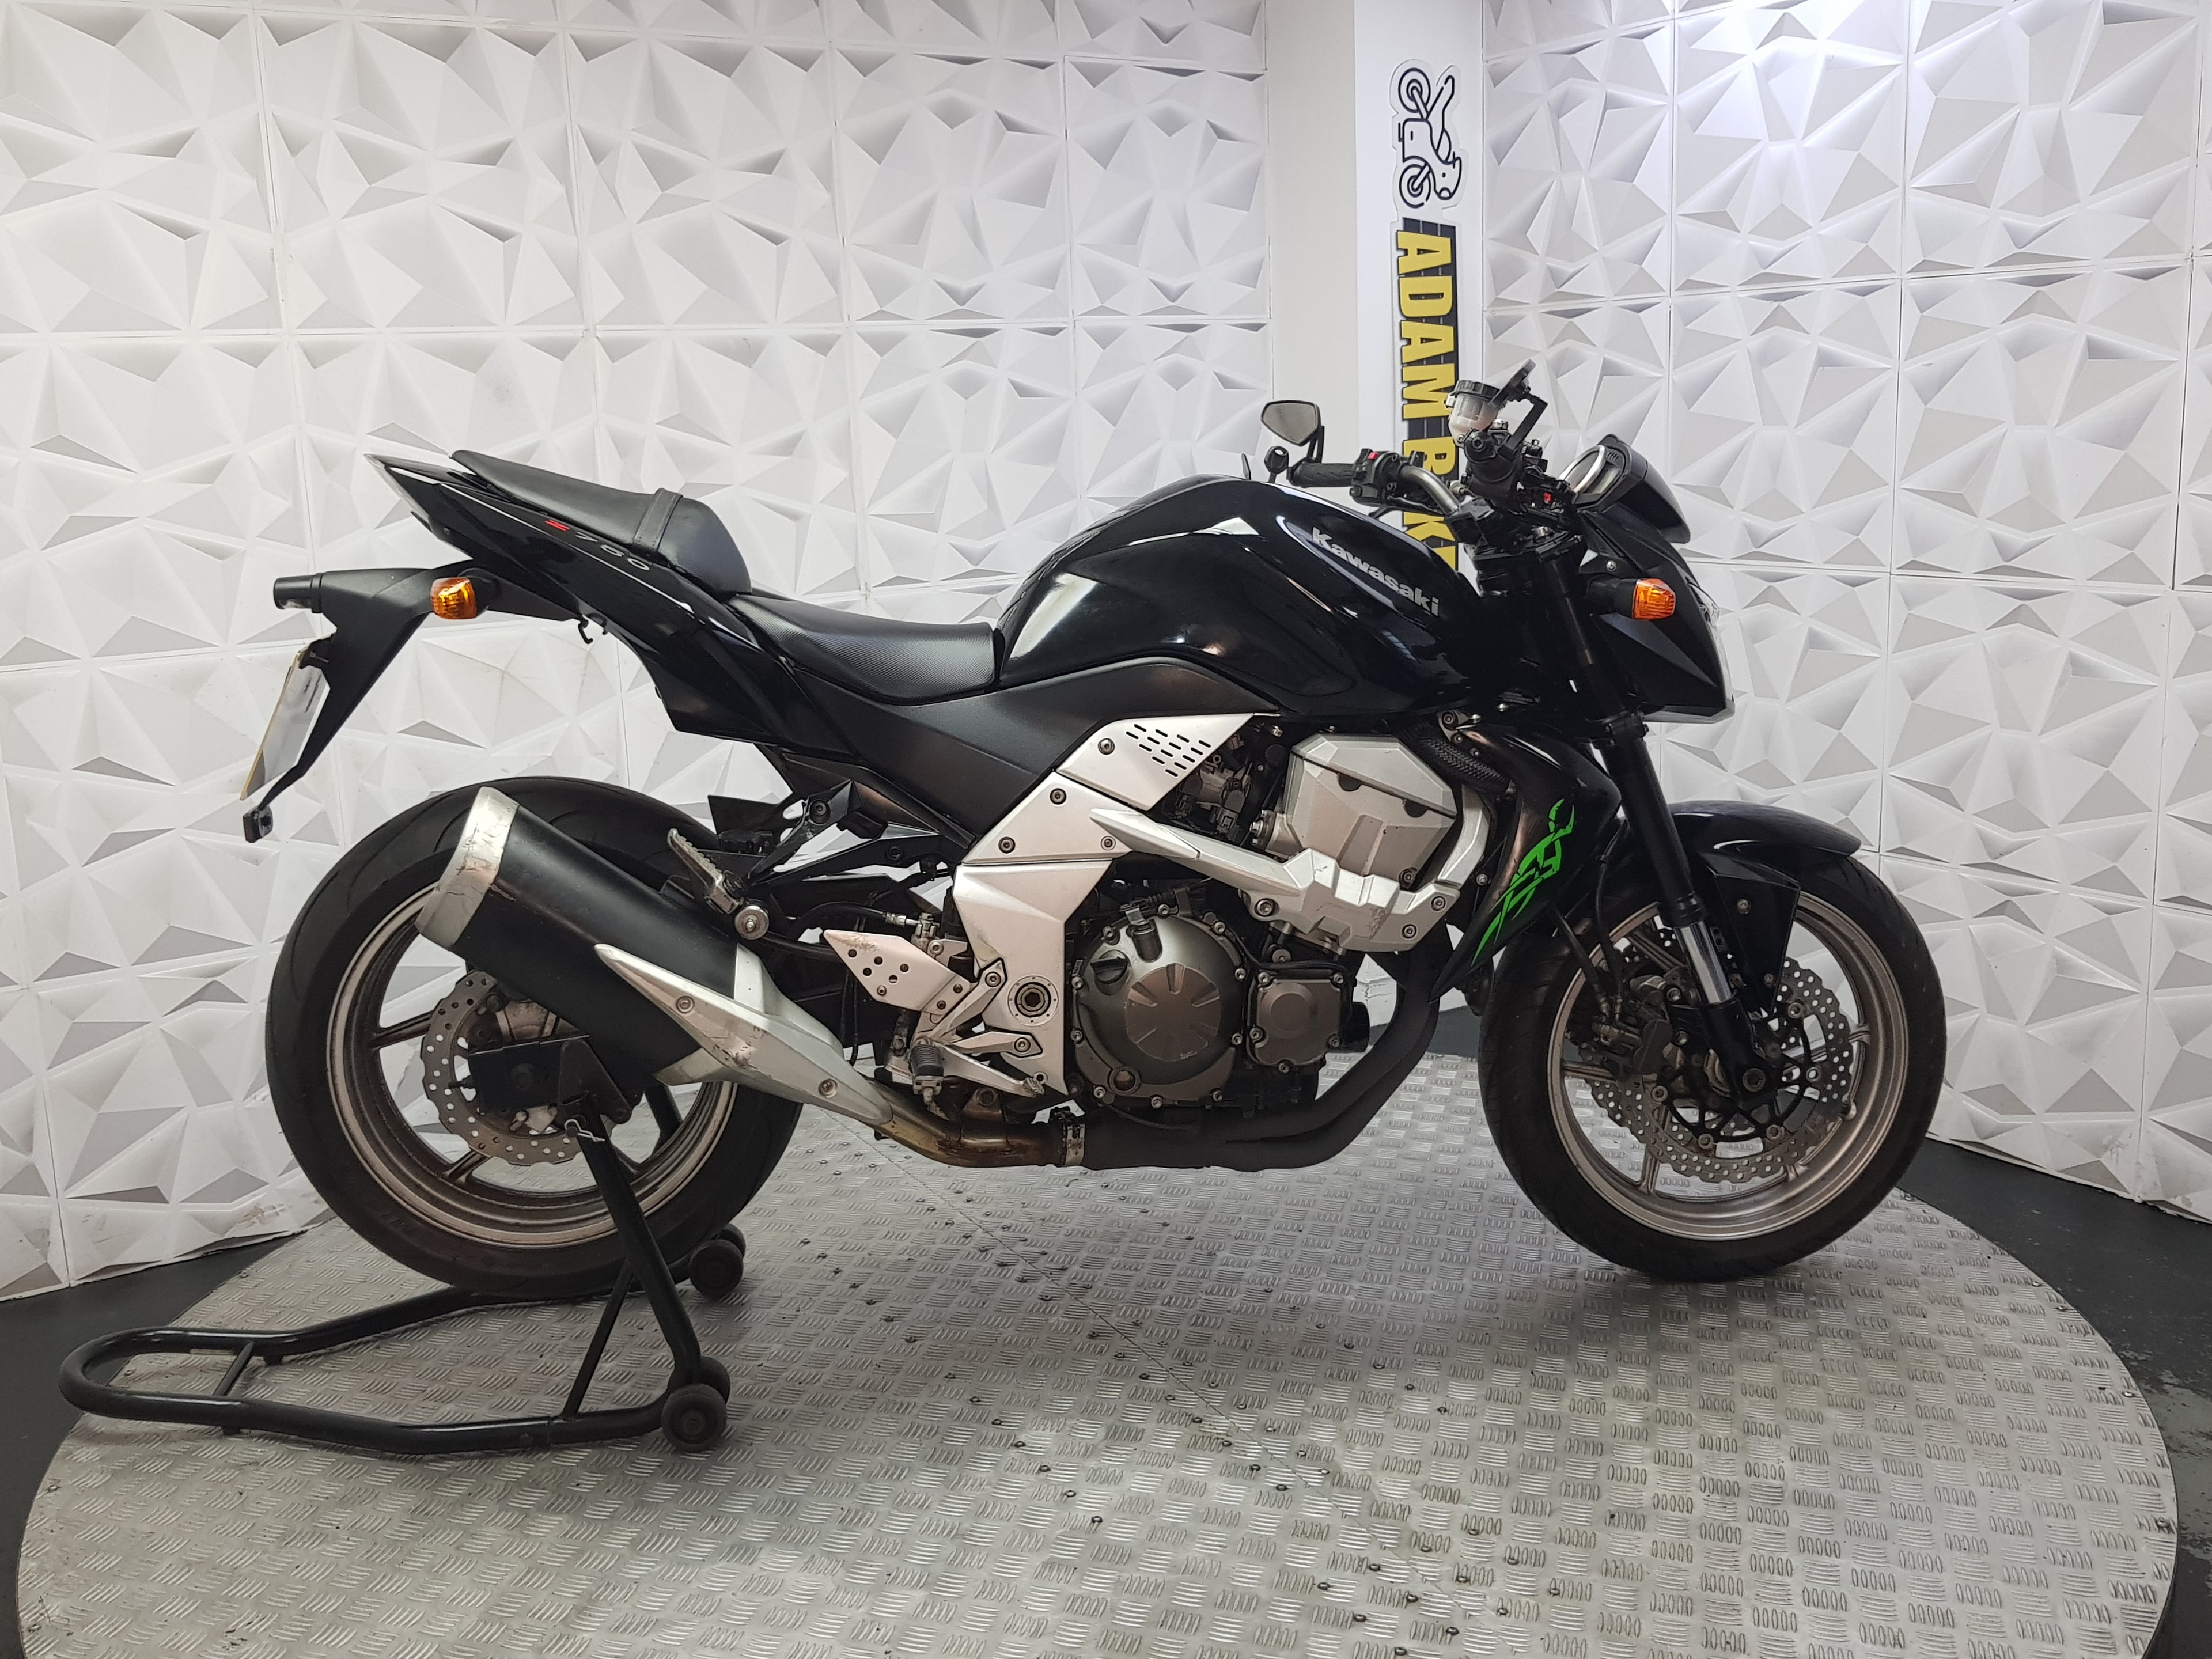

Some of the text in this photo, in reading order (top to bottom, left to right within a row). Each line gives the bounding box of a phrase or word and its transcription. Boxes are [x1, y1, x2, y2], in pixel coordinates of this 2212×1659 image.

[1396, 230, 1456, 571] ADAM BK
[1312, 527, 1440, 617] Kawasaki
